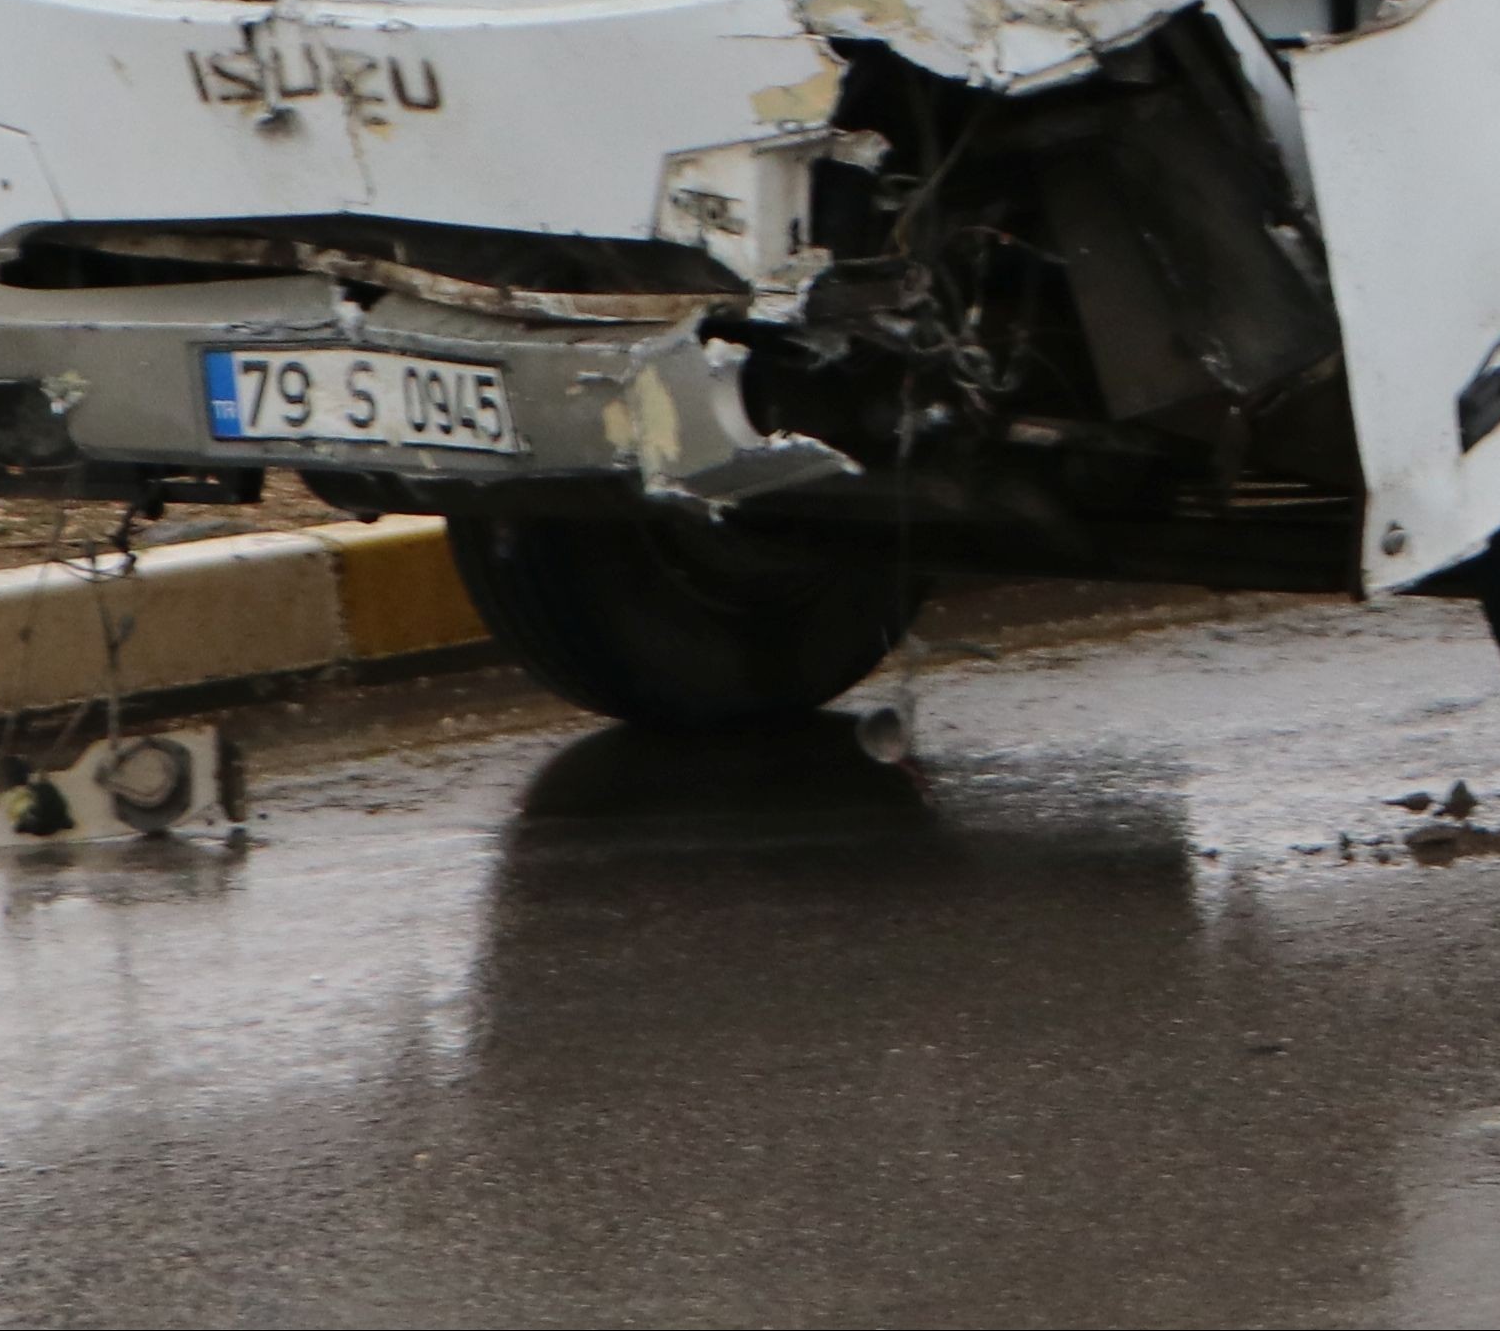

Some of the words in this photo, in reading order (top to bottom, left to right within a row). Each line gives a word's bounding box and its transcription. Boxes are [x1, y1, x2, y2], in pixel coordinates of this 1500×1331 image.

[241, 360, 311, 428] 79
[347, 360, 377, 429] S
[402, 365, 502, 439] 0945
